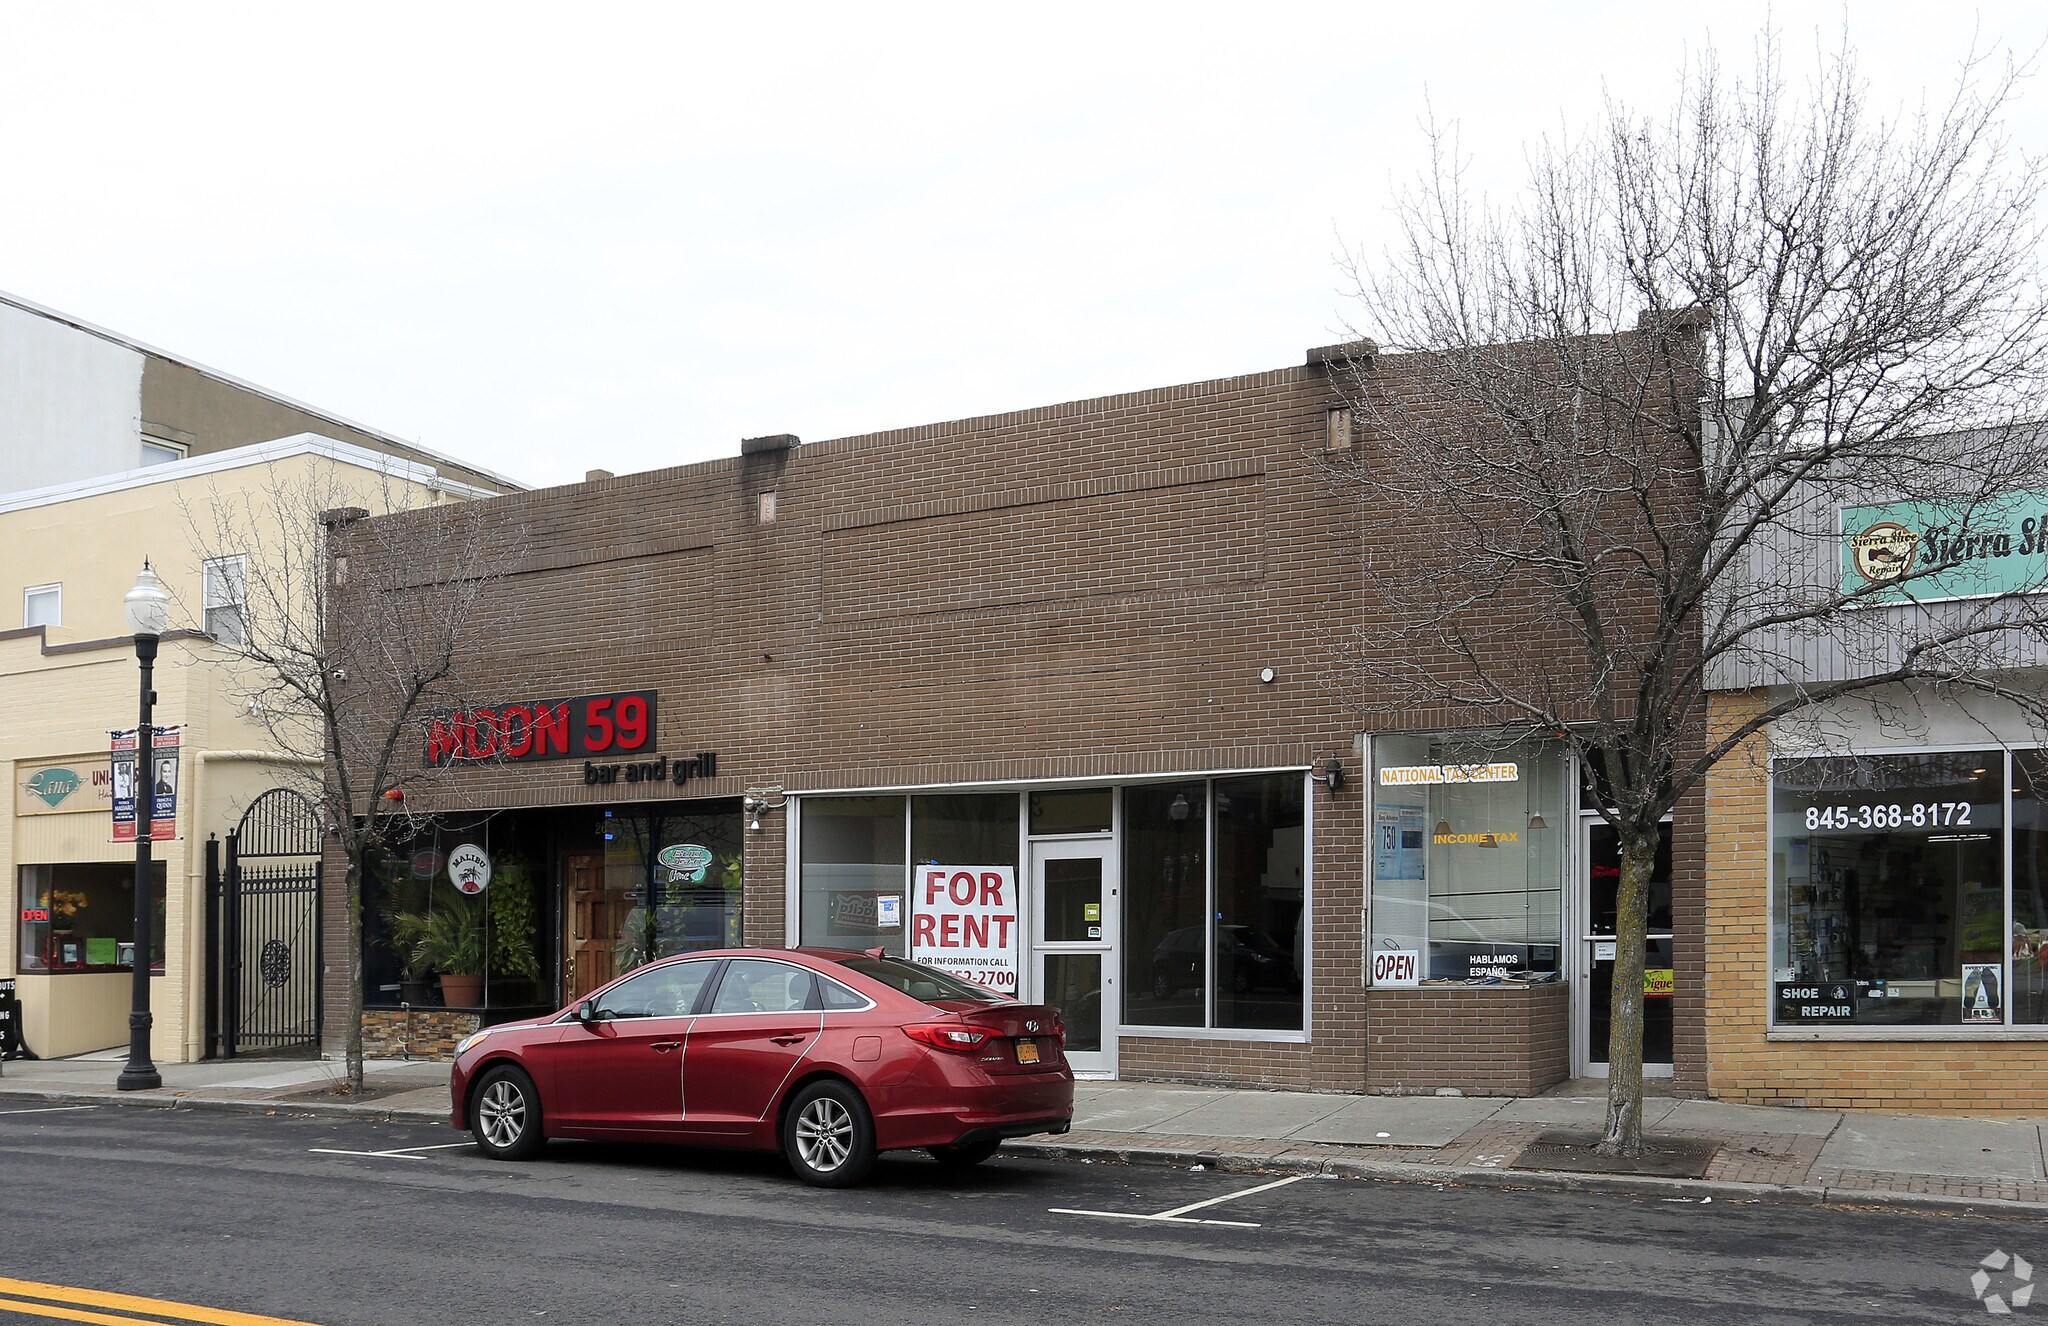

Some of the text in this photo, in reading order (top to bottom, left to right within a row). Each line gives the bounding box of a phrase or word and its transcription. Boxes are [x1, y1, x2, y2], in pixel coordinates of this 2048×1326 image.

[1851, 529, 1918, 547] Sierra Shoe
[1922, 527, 2011, 564] Sierra
[1869, 564, 1900, 575] Repair
[428, 696, 648, 762] MOON 59
[584, 752, 717, 785] bar and grill
[1382, 765, 1516, 783] NATIONAL TAX CENTER
[92, 770, 112, 786] UNI-
[1805, 802, 1972, 830] 845-368-8172
[1382, 825, 1396, 850] 750
[1433, 831, 1518, 845] INCOME TAX
[452, 853, 486, 868] MALIBU
[926, 871, 1003, 906] FOR
[22, 909, 48, 921] OPEN
[913, 914, 1015, 949] RENT
[917, 956, 1009, 966] FOR INFORMATION CALL
[1375, 954, 1415, 981] OPEN
[1469, 954, 1518, 964] HABLAMOS
[947, 969, 1015, 986] 2-2700
[1469, 965, 1510, 976] ESPAÑOL
[1643, 972, 1673, 991] Sigue
[1782, 987, 1819, 999] SHOE
[1801, 1005, 1851, 1017] REPAIR
